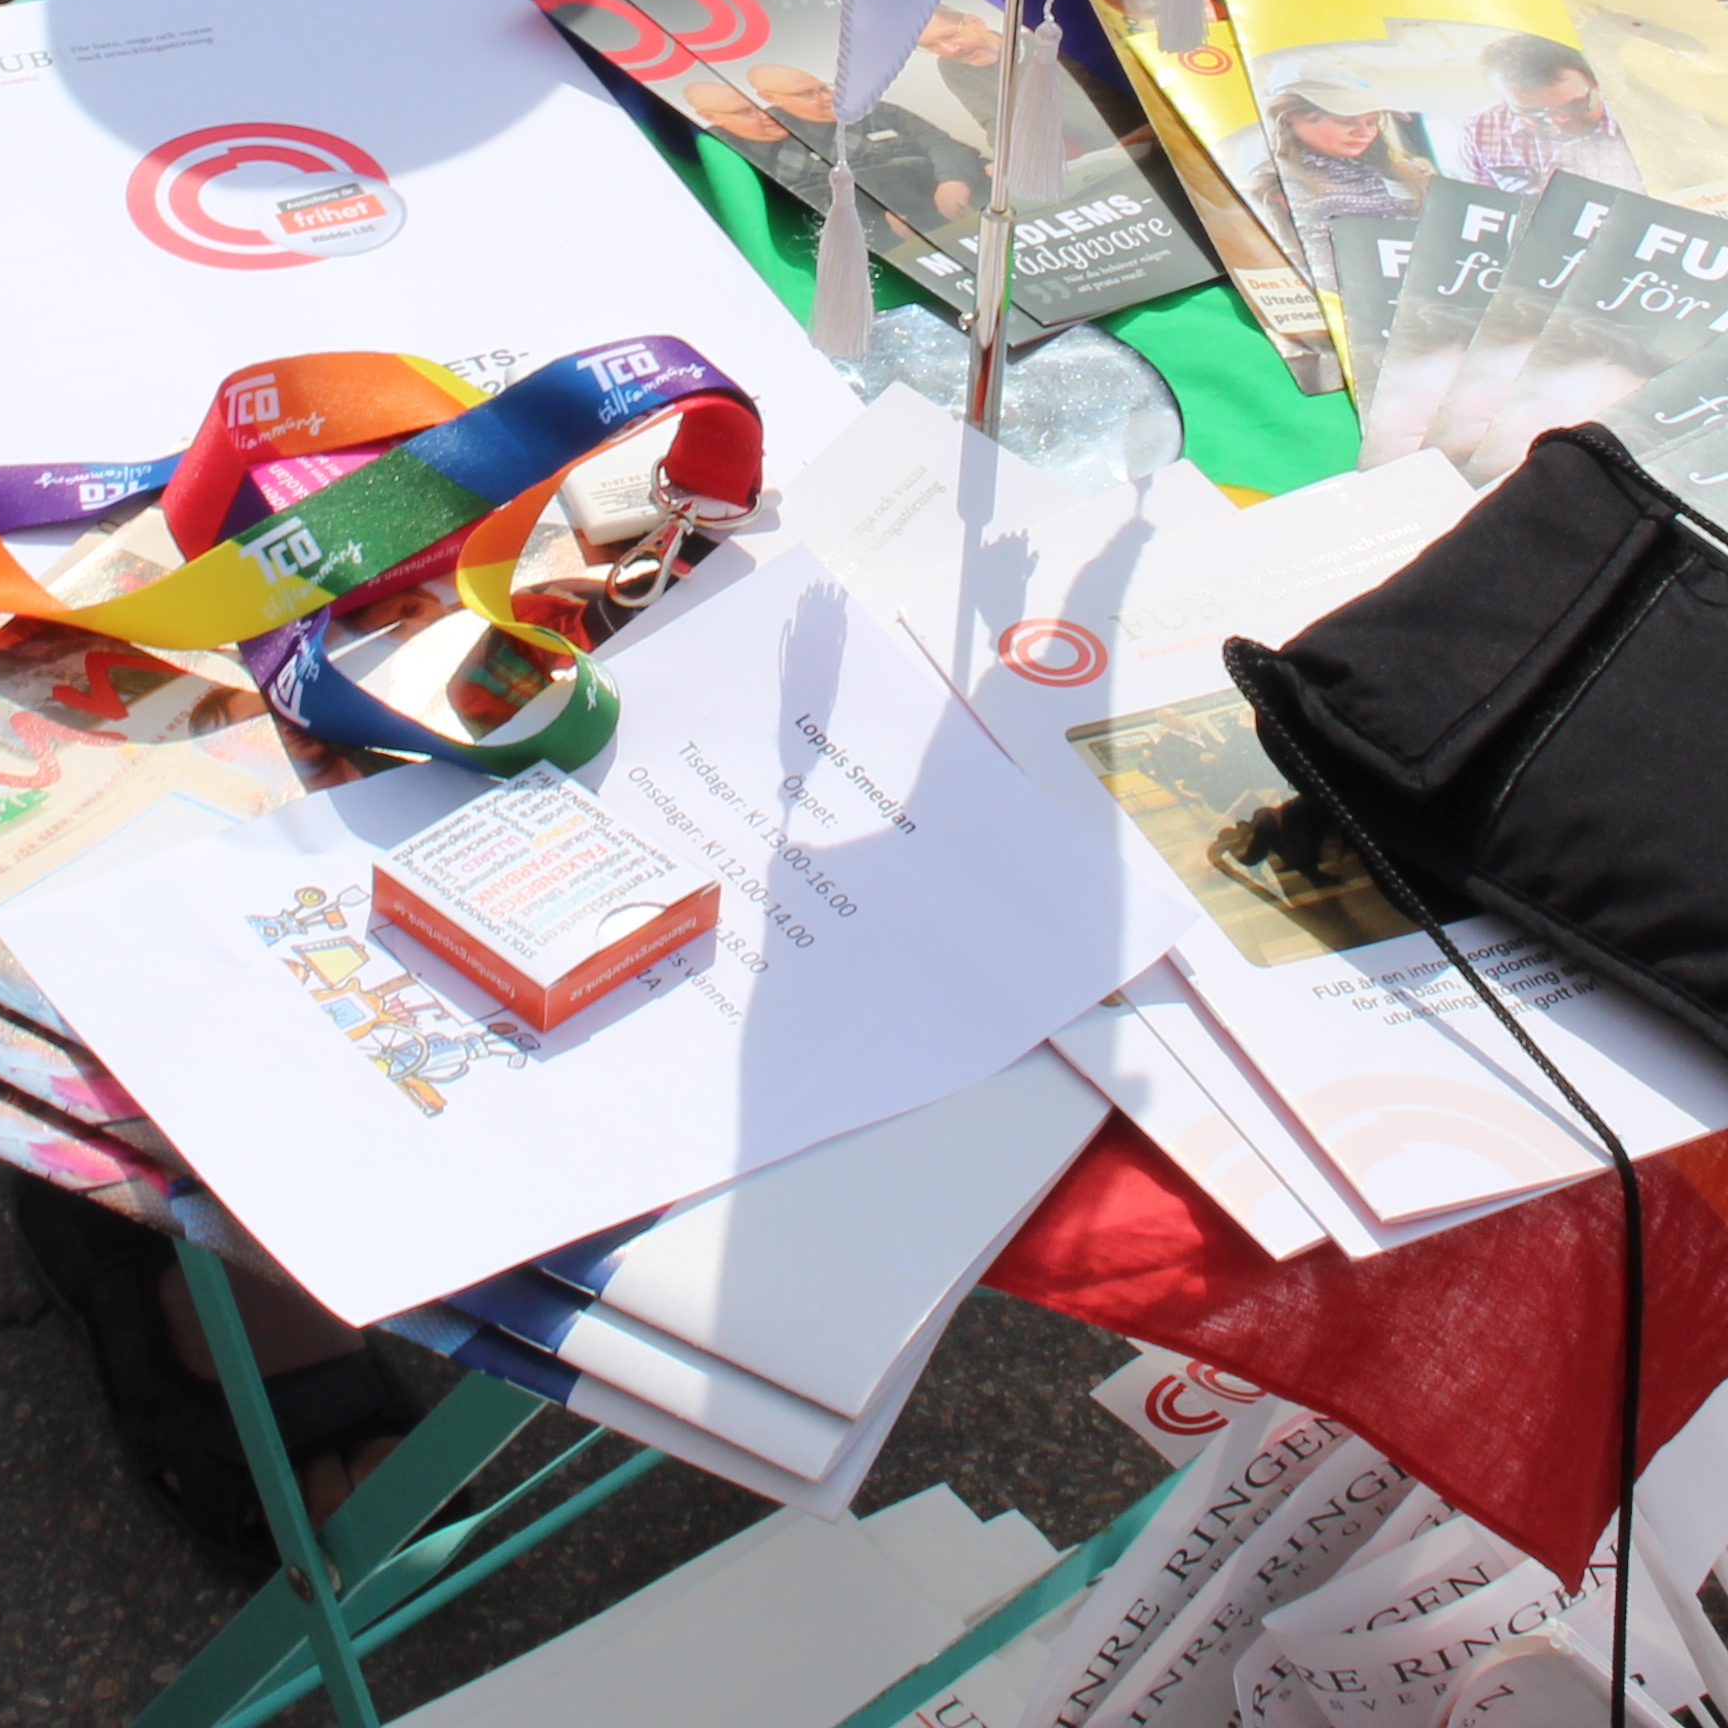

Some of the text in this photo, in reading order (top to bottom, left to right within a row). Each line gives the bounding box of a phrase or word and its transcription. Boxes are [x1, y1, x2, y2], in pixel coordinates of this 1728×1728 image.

[293, 201, 368, 228] frihet
[1012, 216, 1173, 280] ådgivare
[1597, 270, 1711, 321] för
[576, 342, 661, 393] TCO
[224, 372, 281, 429] TCO
[239, 515, 323, 585] TCO
[529, 768, 615, 827] FALKENBERG
[783, 772, 839, 829] Öppet:
[795, 713, 917, 835] Loppis Smedjan
[457, 833, 523, 875] ULLARED
[628, 766, 705, 843] Onsdagar:
[701, 839, 727, 860] Kl
[718, 856, 815, 949] 12.00-14.00
[678, 740, 857, 918] Tisdagar: Kl 13.00-16.00
[467, 847, 563, 907] SPARBANK
[484, 841, 610, 919] FALKENBERGS
[529, 863, 667, 948] Framtidsbanken
[685, 966, 744, 1025] vänner,
[1312, 981, 1357, 1001] FUB
[1360, 973, 1376, 990] är
[1382, 970, 1406, 986] en
[1351, 994, 1380, 1013] för
[1384, 988, 1409, 1005] att
[1410, 976, 1463, 999] barn,
[1382, 969, 1559, 1028] utvecklingstörning
[1534, 986, 1574, 1011] gott
[1130, 1460, 1412, 1725] INRE RING
[1055, 1597, 1160, 1728] INRE
[1330, 1683, 1449, 1712] SVER
